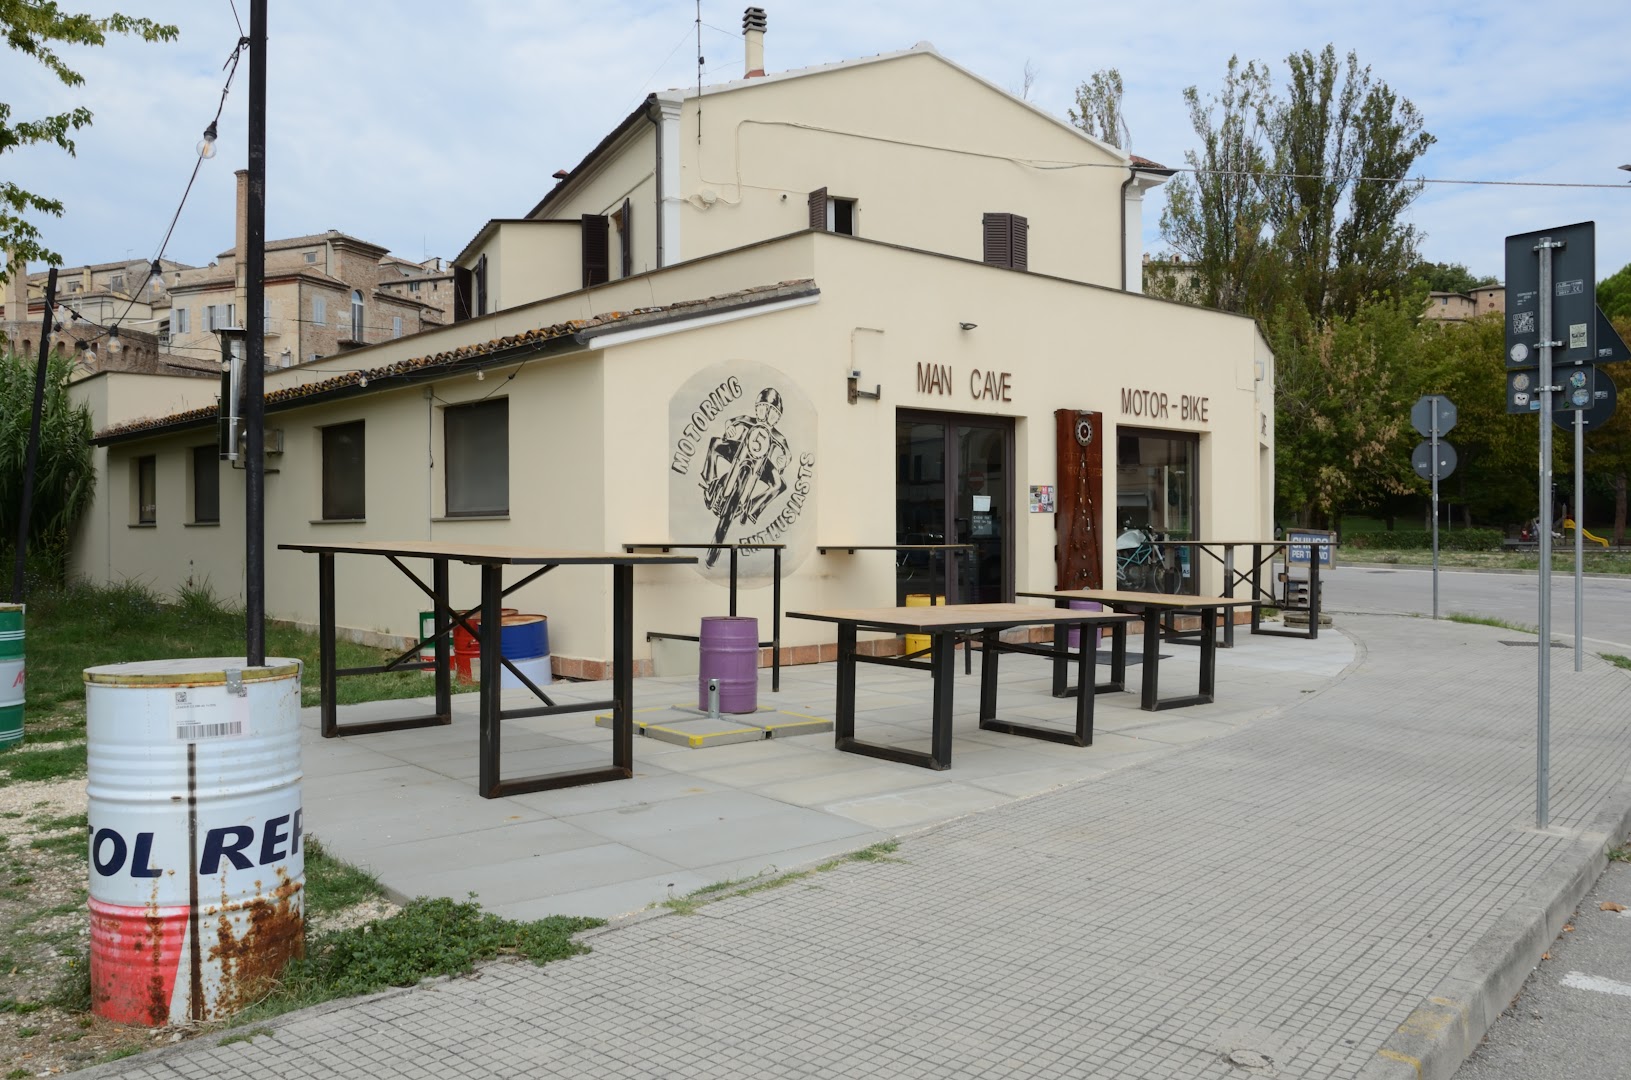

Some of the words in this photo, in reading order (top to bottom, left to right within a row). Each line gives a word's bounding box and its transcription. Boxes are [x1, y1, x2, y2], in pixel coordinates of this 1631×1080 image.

[917, 361, 952, 396] MAN
[970, 368, 1012, 402] CAVE
[671, 375, 743, 475] MOTORING
[752, 431, 767, 453] 5
[739, 451, 815, 557] ENTHUSIASTS
[1292, 550, 1304, 559] PER
[1305, 550, 1328, 560] TNO
[88, 825, 163, 878] OL
